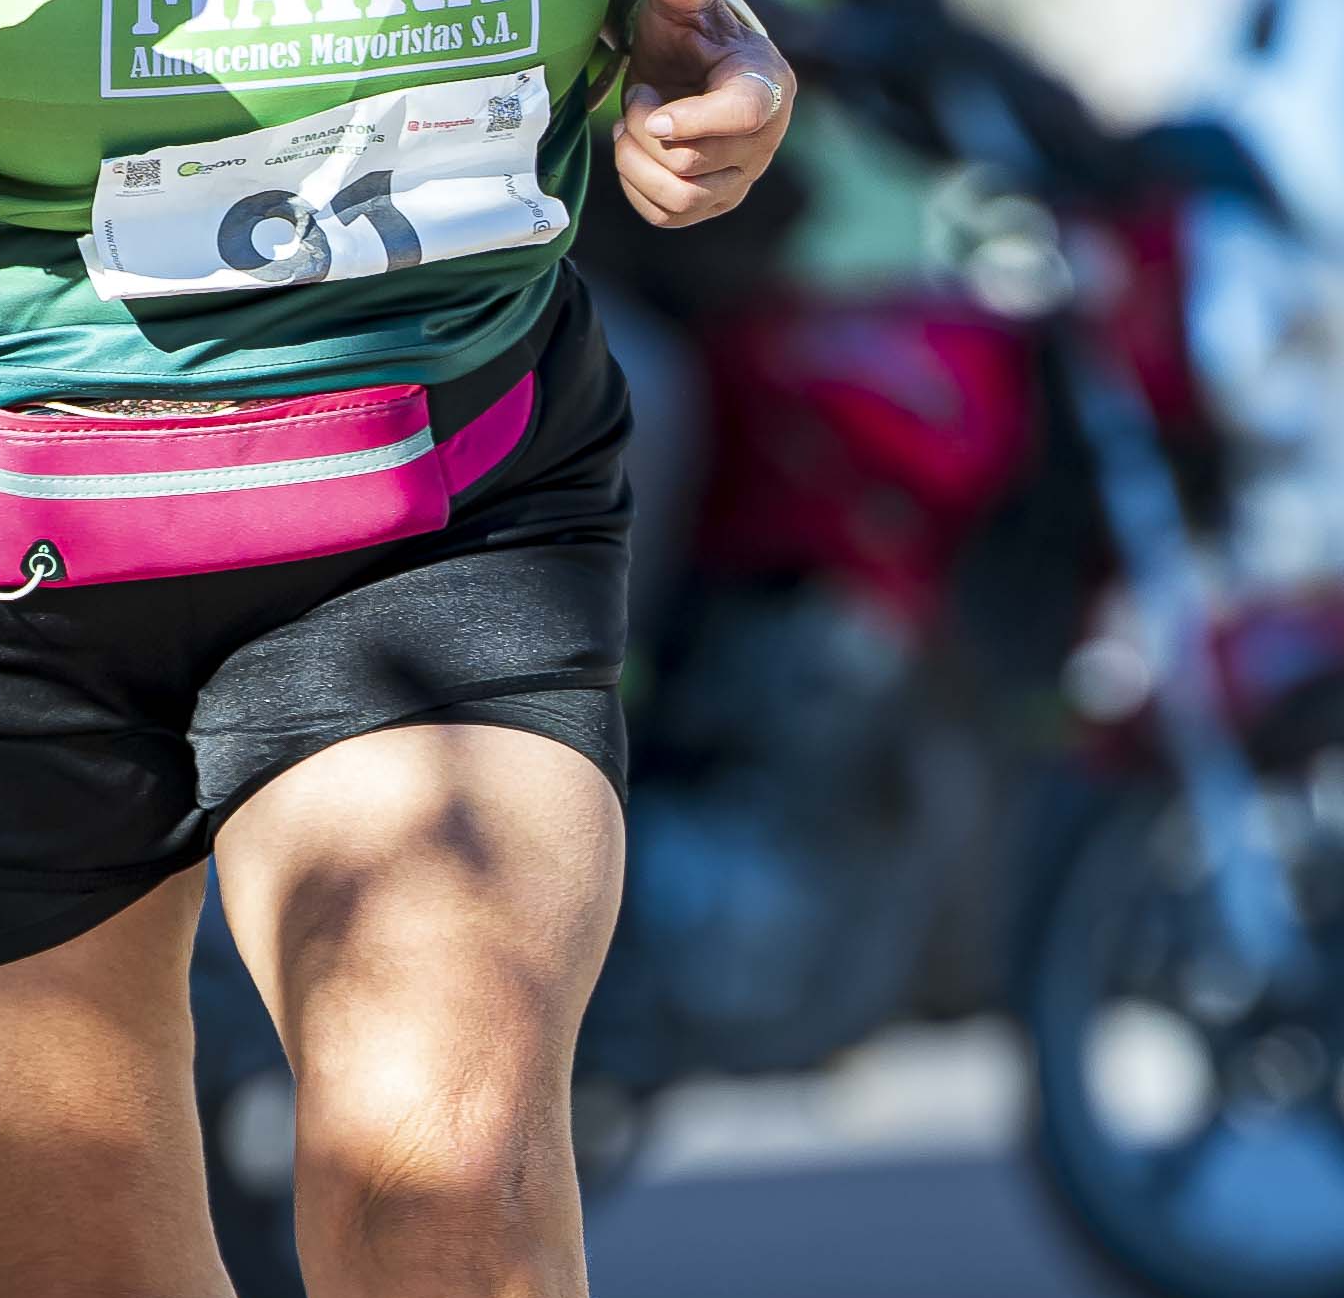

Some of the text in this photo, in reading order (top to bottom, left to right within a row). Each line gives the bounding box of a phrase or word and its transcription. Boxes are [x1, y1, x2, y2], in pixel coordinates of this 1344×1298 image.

[130, 11, 519, 79] Almacenes Mayoristas S.A.
